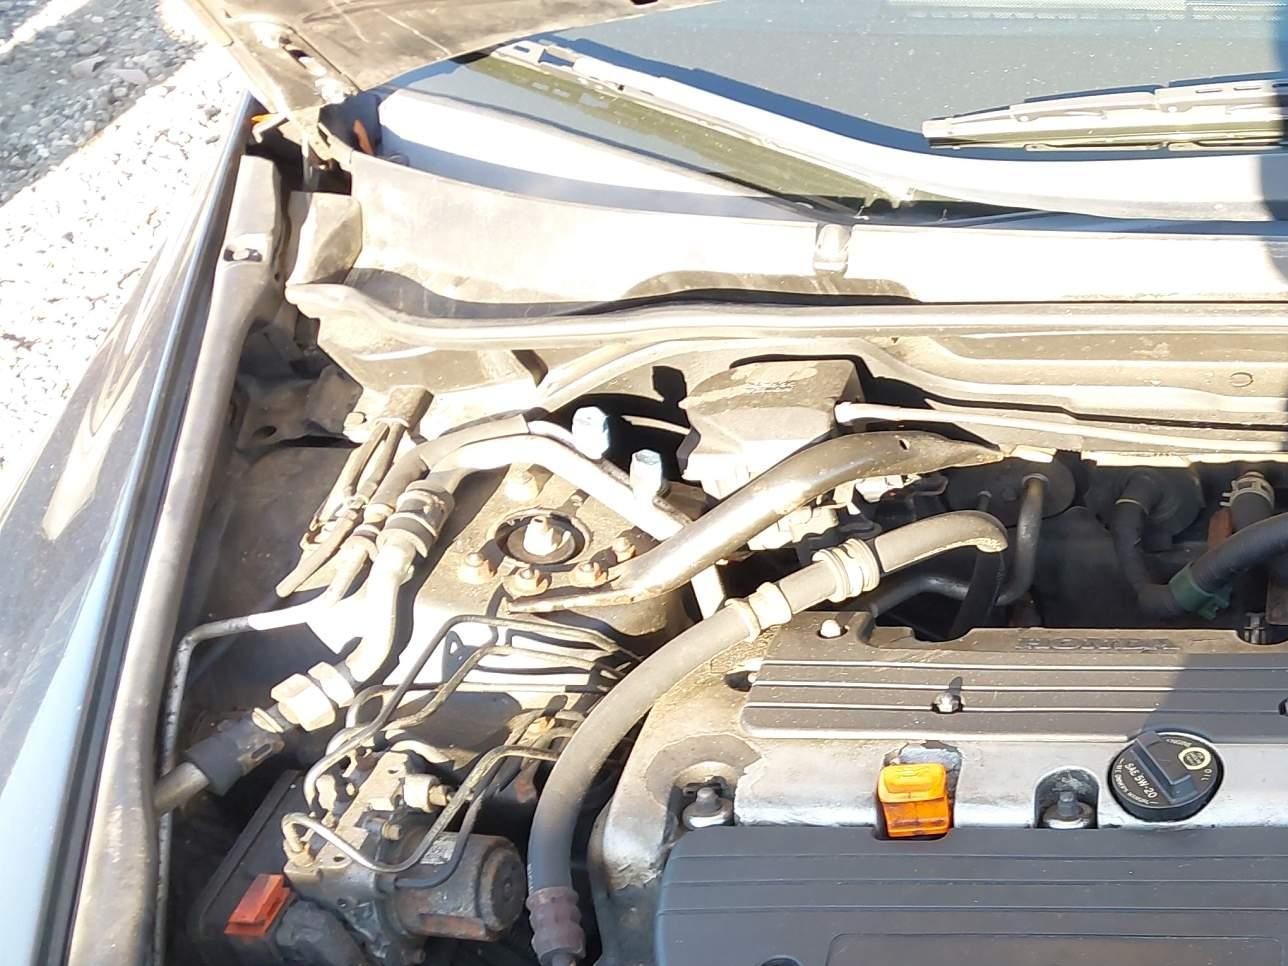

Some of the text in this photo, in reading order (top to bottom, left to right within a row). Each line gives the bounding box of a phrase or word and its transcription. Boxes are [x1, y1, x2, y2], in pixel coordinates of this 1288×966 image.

[1124, 763, 1158, 798] SAE 5W-20
[1200, 768, 1213, 781] OIL
